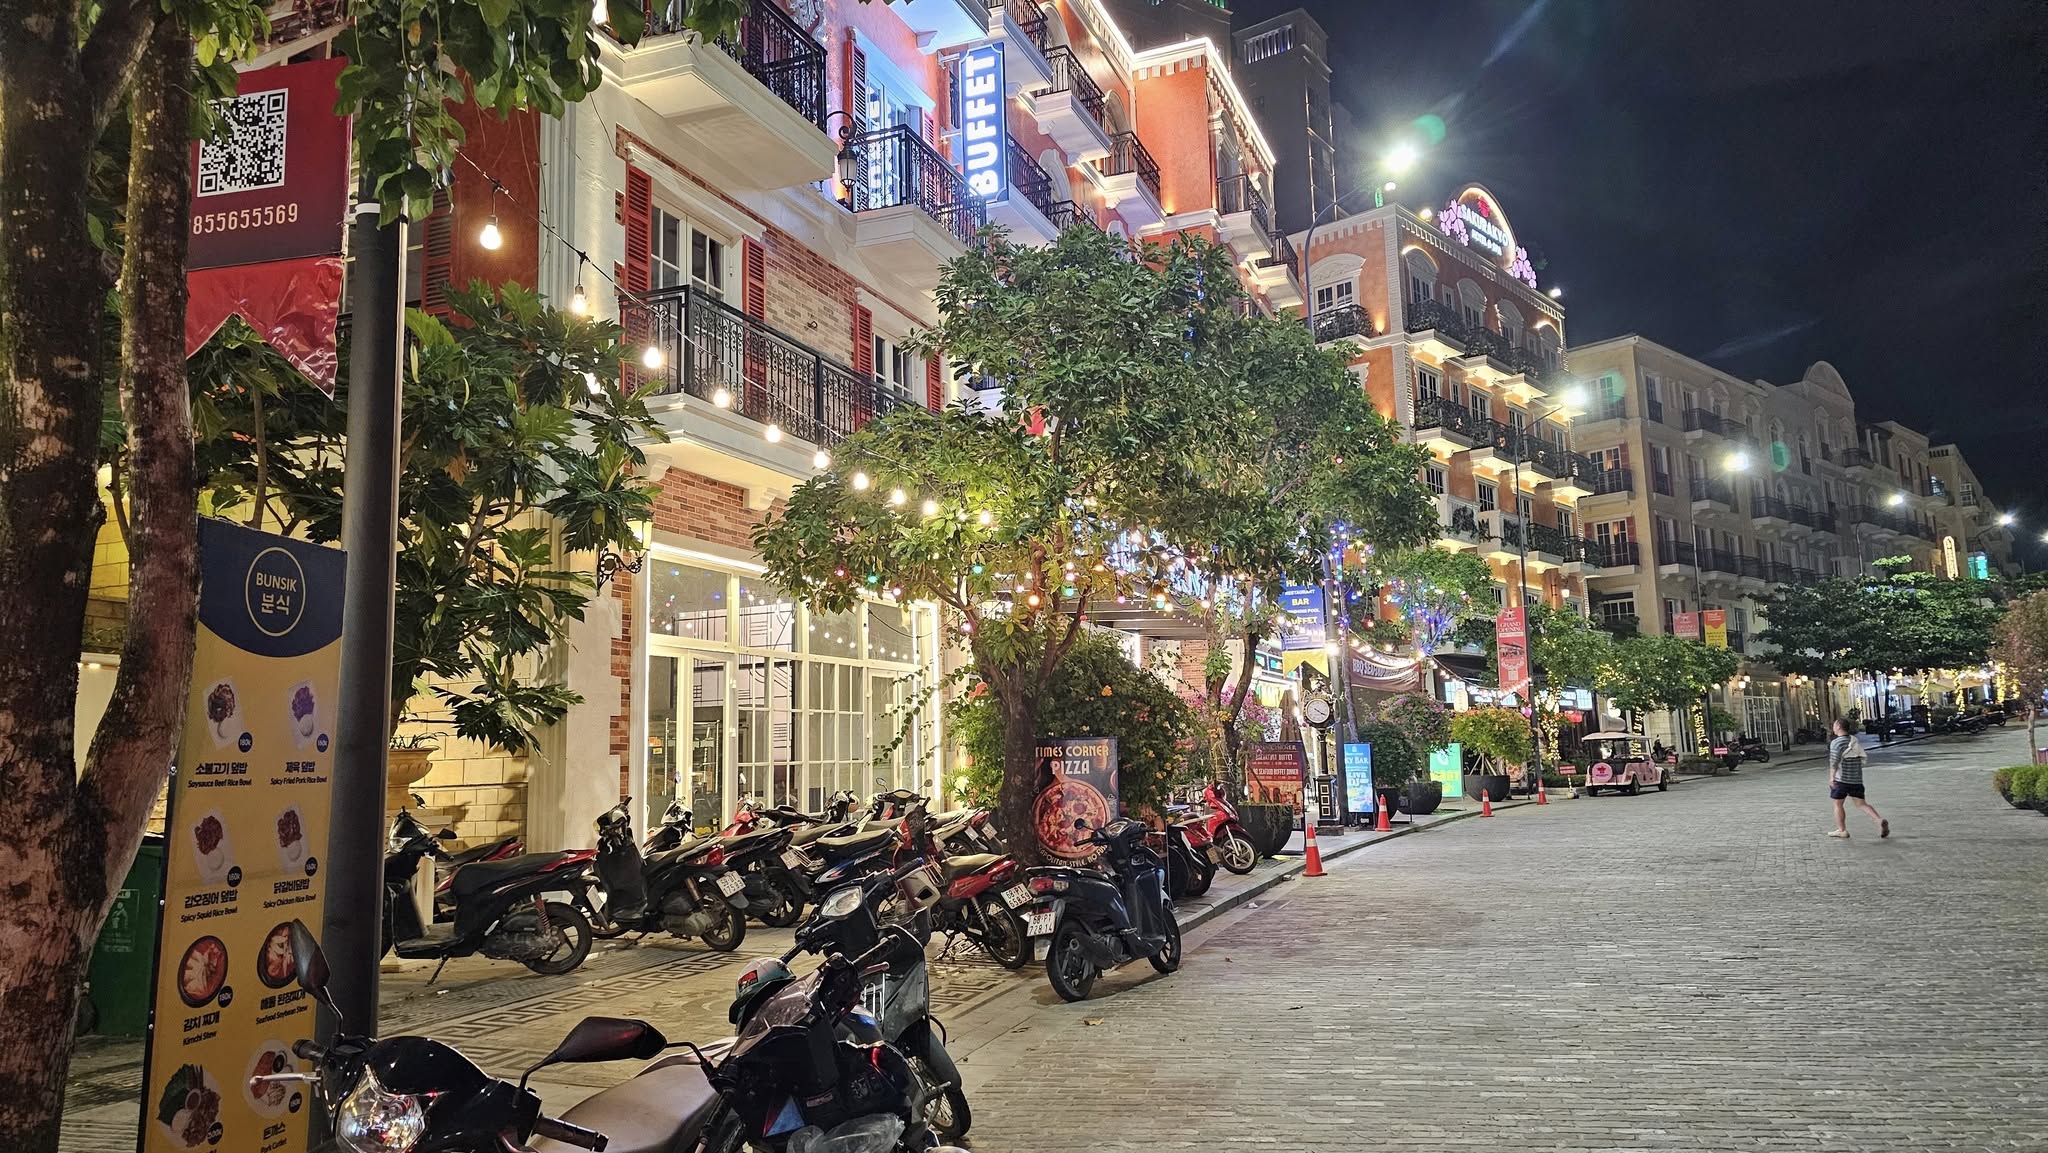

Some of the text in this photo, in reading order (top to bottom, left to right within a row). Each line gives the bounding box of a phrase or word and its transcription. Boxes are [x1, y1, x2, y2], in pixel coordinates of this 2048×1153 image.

[966, 55, 999, 196] BUFFET
[192, 203, 299, 235] 855655569
[1461, 204, 1508, 247] SAKURAKYO
[256, 572, 297, 592] BUNSIK
[261, 593, 290, 616] 분식
[1292, 598, 1309, 606] BAR
[1291, 616, 1317, 625] UFFET
[1035, 745, 1109, 758] TIMES CORNER
[1051, 760, 1090, 775] PIZZA
[214, 779, 227, 787] Beef
[227, 779, 238, 787] Rice
[270, 777, 283, 786] Spicy
[1088, 853, 1097, 863] NO
[263, 900, 277, 909] Spicy
[180, 906, 238, 923] Spicy Squid Rice Bowl
[183, 1030, 217, 1046] Kimchi Stew
